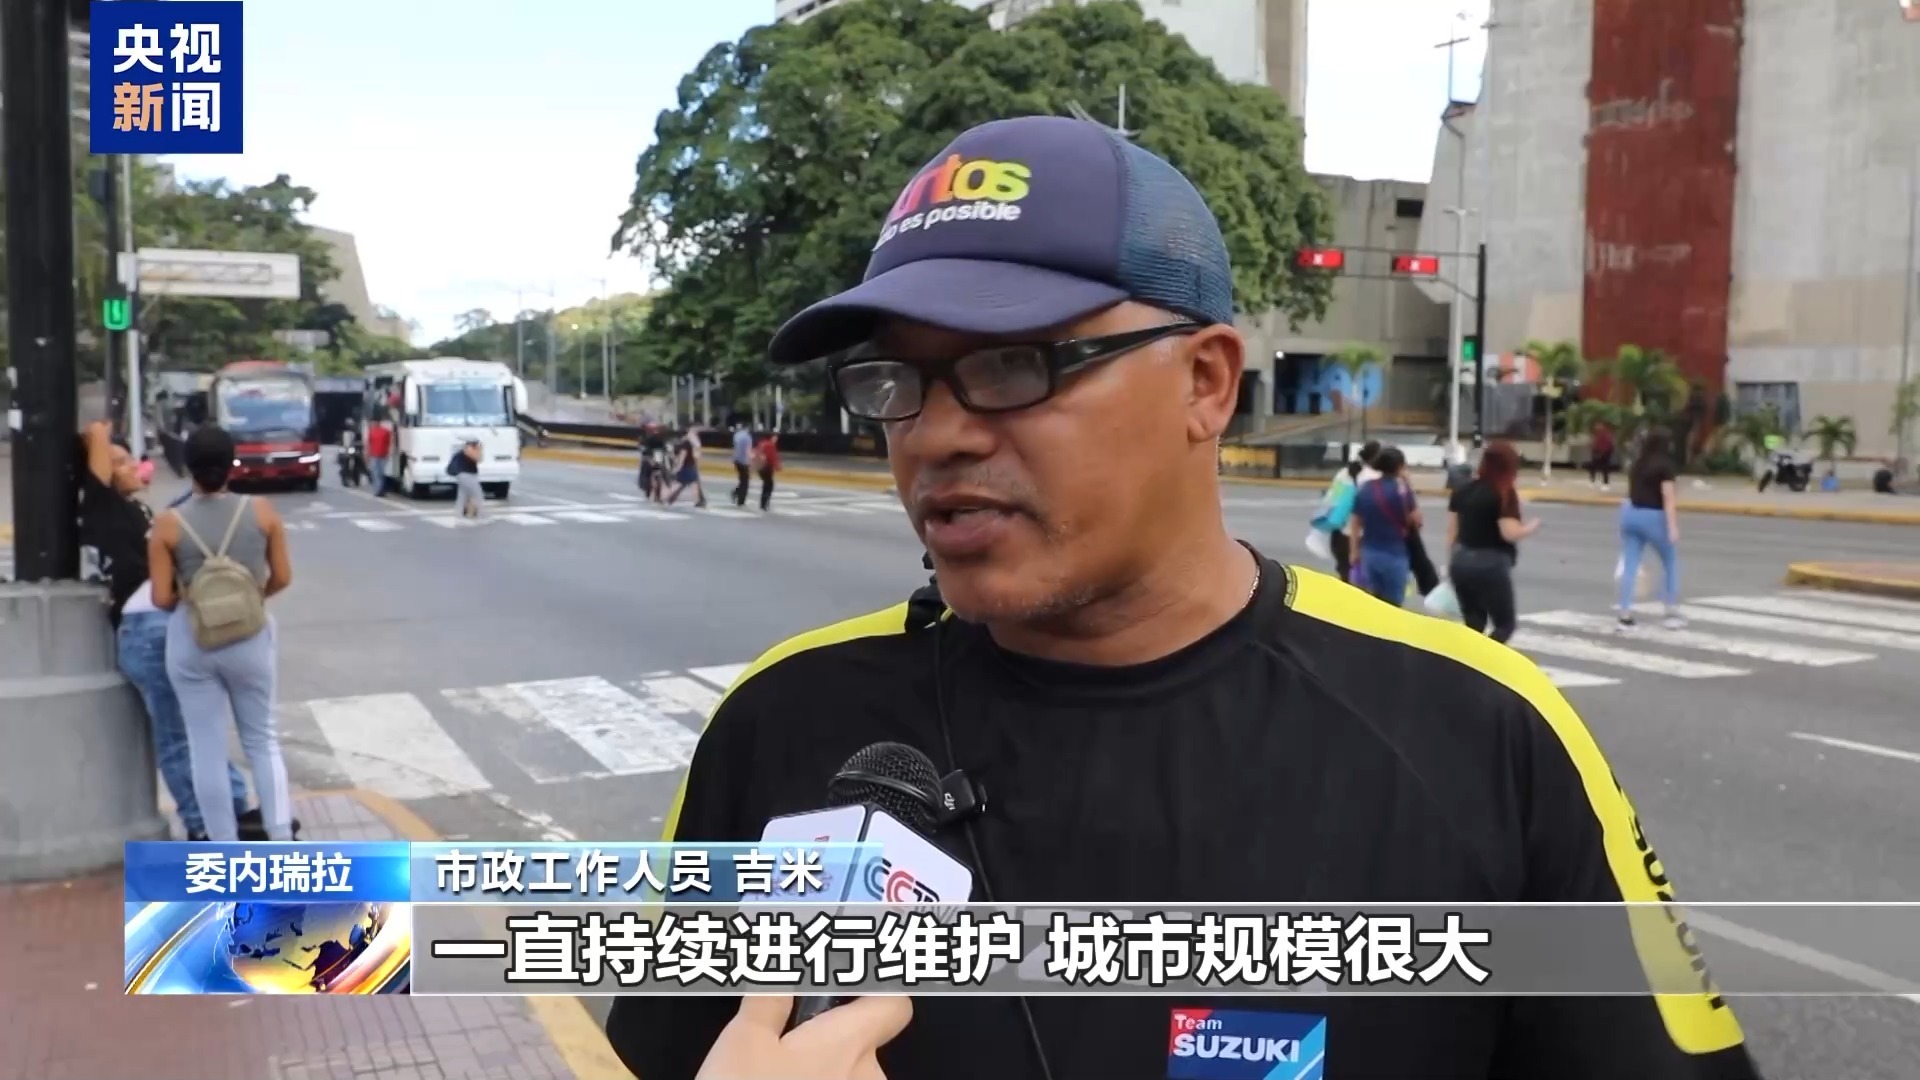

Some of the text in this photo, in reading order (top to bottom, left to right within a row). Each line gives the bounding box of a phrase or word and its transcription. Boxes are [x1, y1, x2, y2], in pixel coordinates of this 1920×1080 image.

[899, 212, 925, 234] es
[923, 201, 1021, 231] posible
[1174, 1014, 1223, 1030] Team
[1173, 1033, 1300, 1063] SUZUKI
